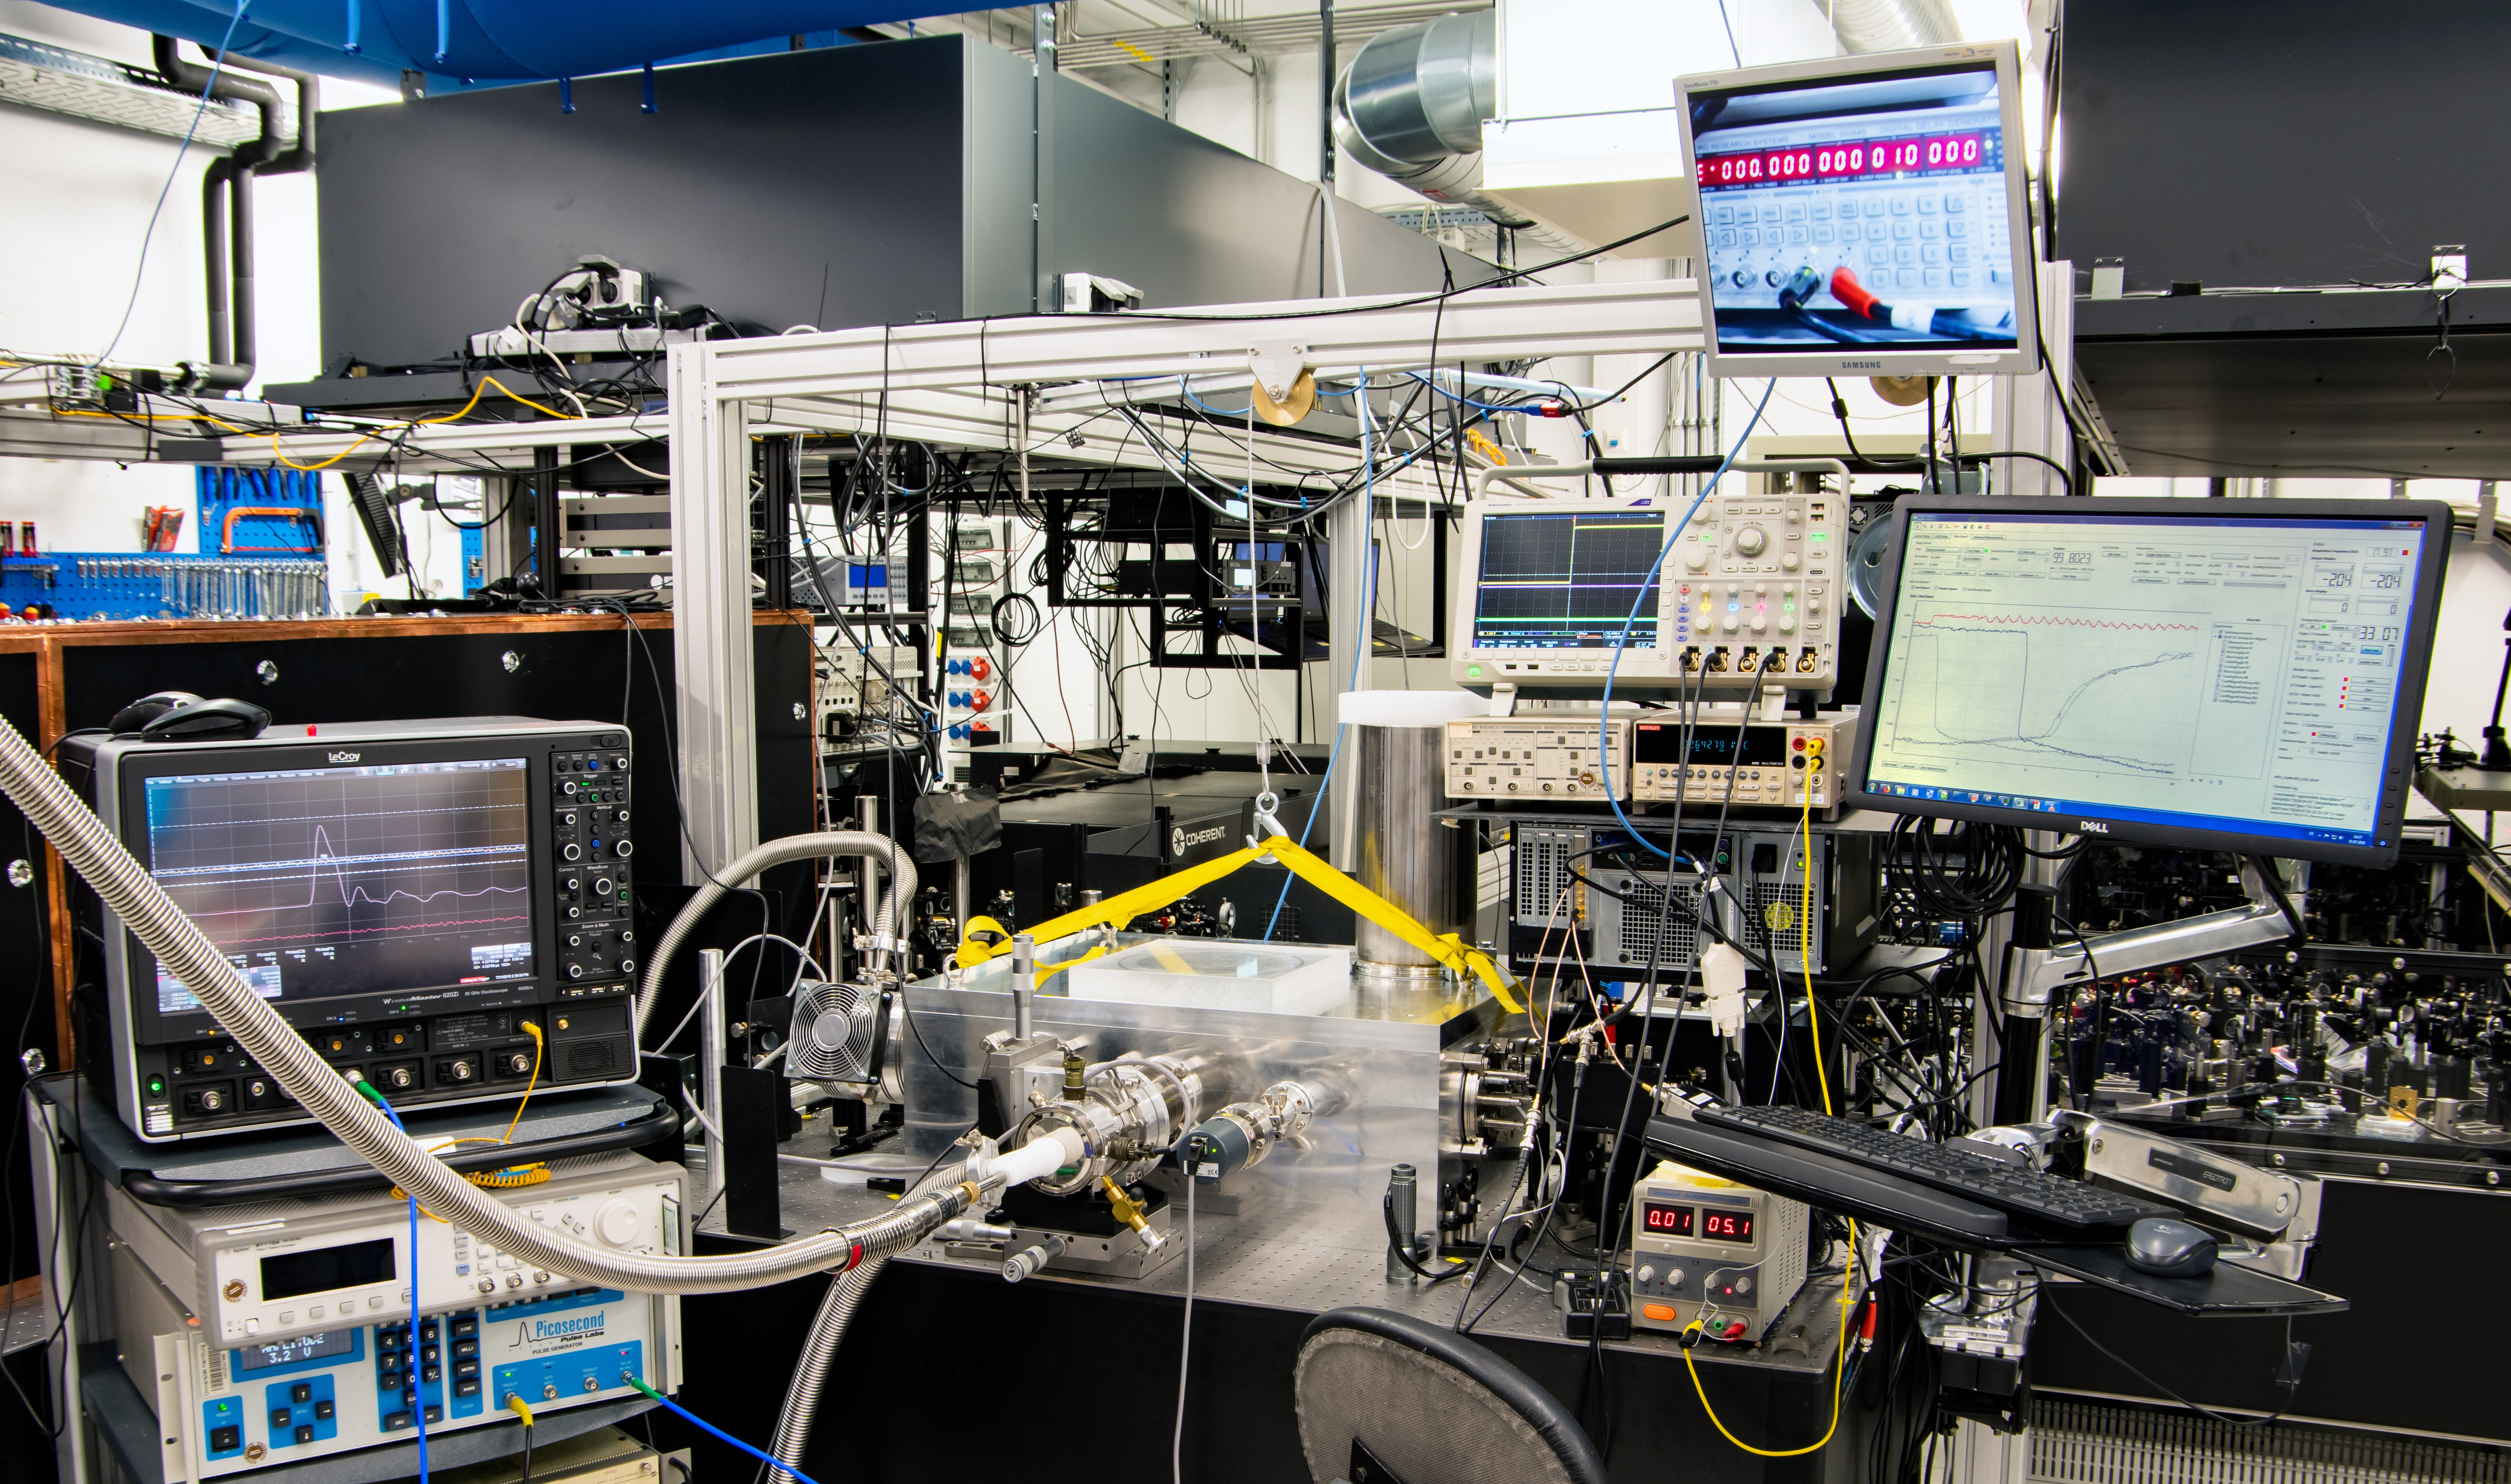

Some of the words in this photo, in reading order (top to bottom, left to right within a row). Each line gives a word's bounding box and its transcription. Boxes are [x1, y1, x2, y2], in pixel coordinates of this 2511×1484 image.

[1711, 138, 1751, 150] RESEARCH
[1754, 136, 1789, 146] SYSTEMS
[1809, 132, 1836, 140] MODEL
[1880, 125, 1912, 134] DIGITAL
[1916, 122, 1944, 131] DELAY
[328, 752, 361, 762] LeCroy
[2081, 821, 2108, 833] DELL
[1186, 826, 1225, 846] COHERENT
[1649, 1211, 1690, 1227] 0.01
[1708, 1217, 1749, 1234] 05.1
[536, 1310, 604, 1338] Picosecond
[561, 1335, 583, 1343] Pulse
[303, 1347, 312, 1357] V
[532, 1347, 550, 1355] PULSE
[551, 1342, 583, 1352] GENERATOR
